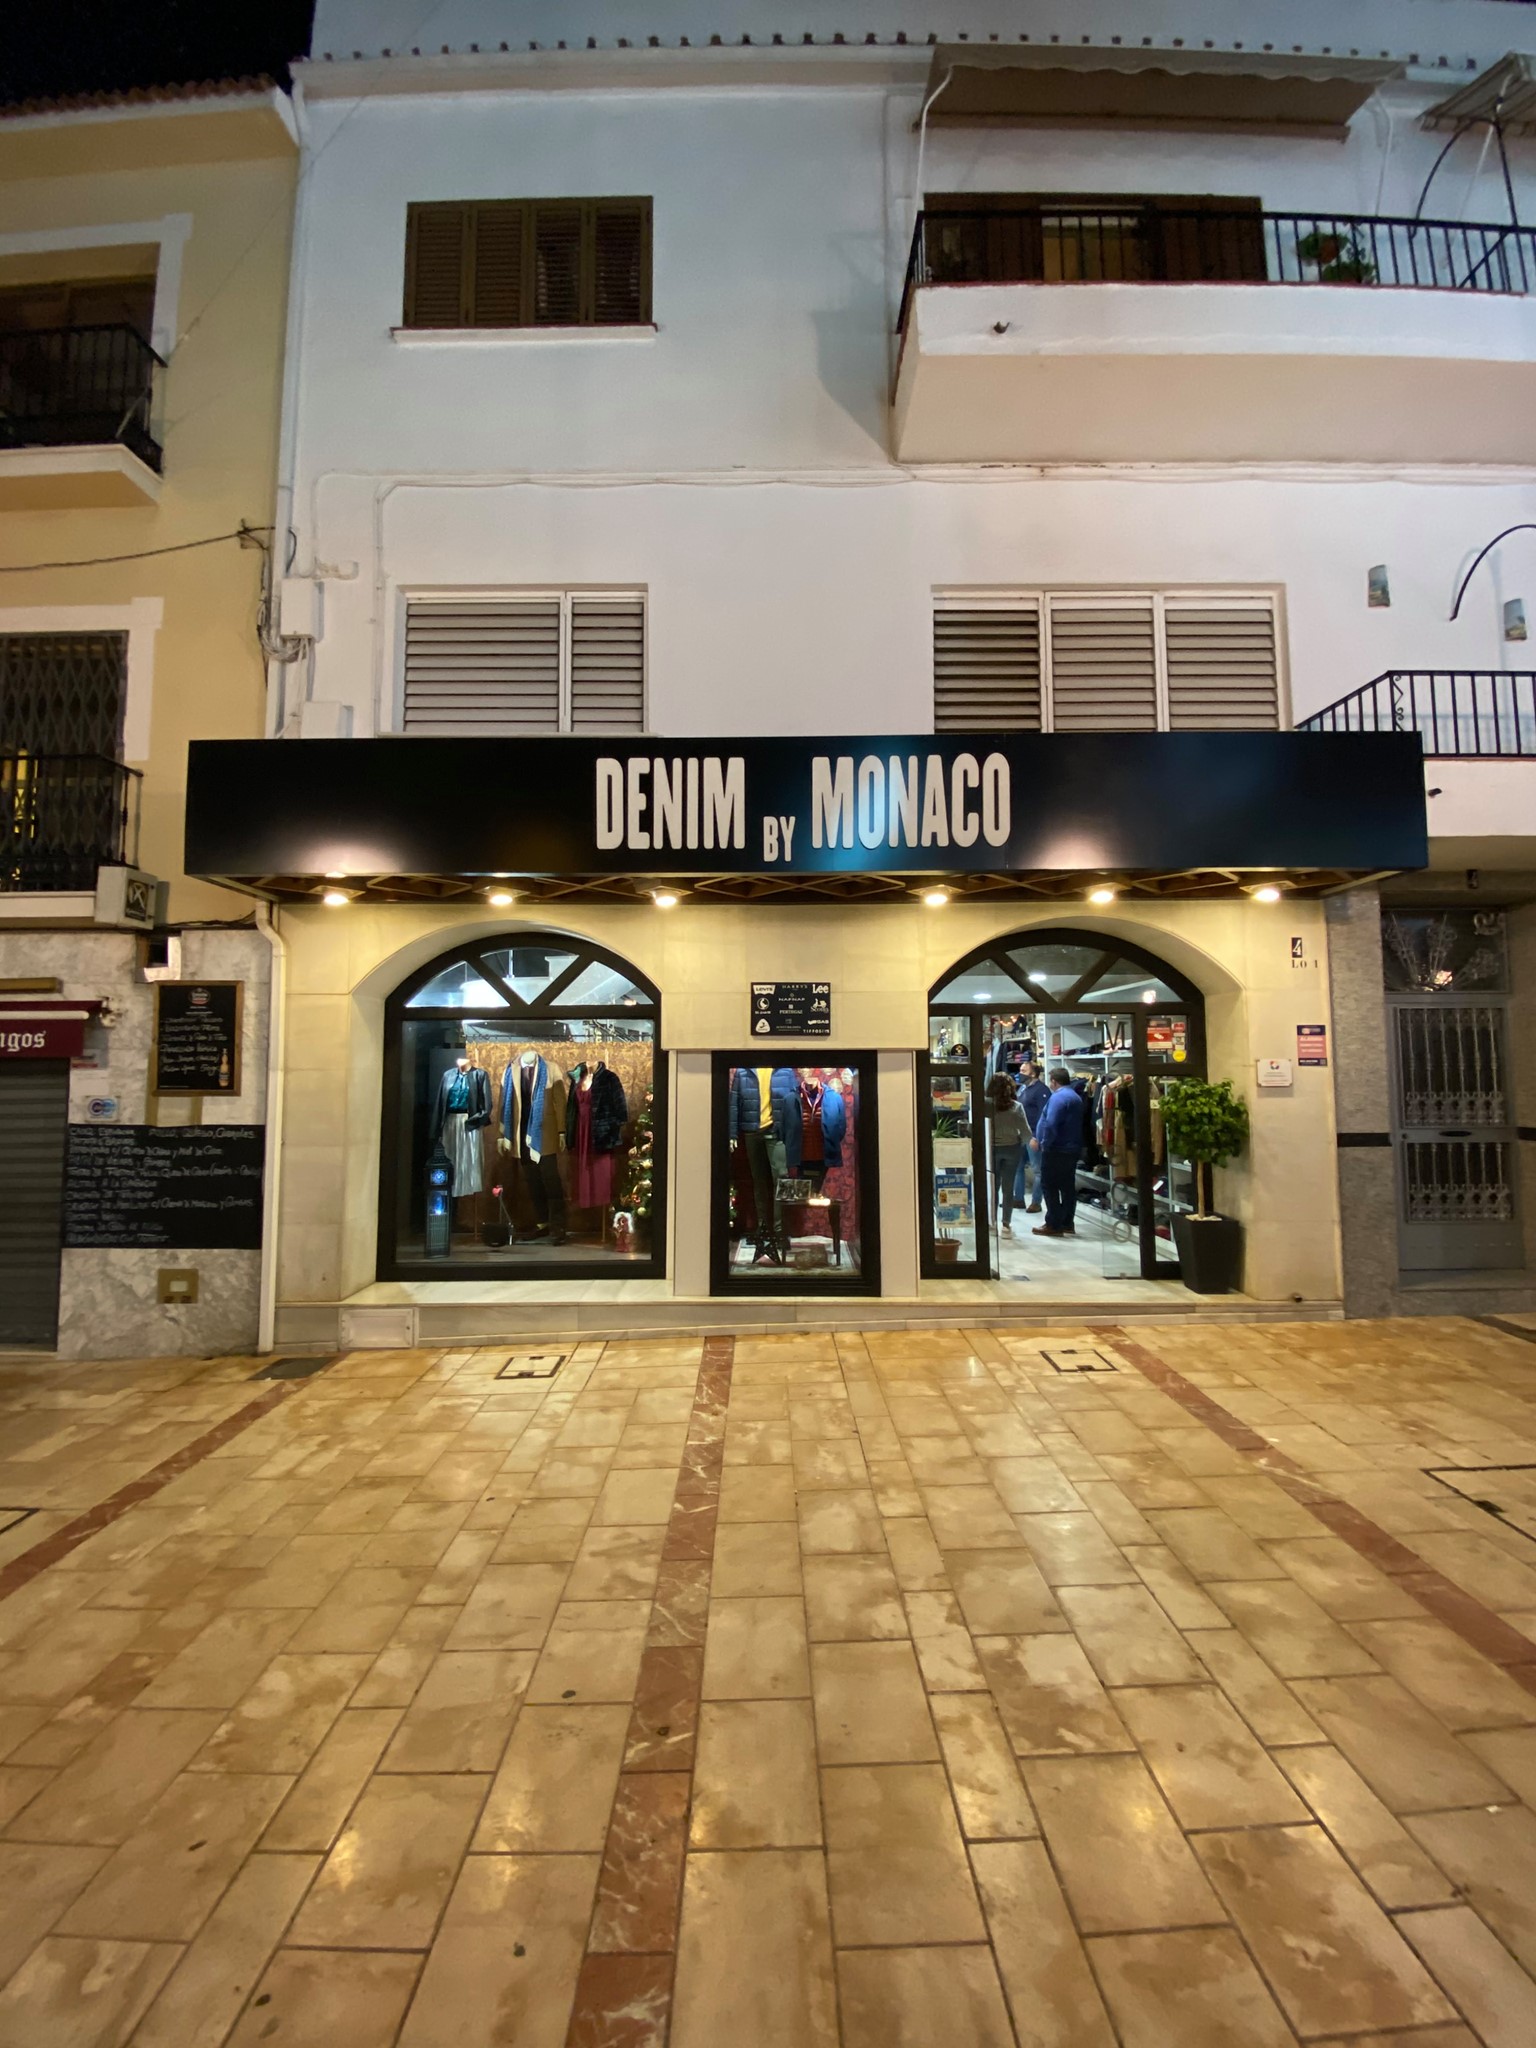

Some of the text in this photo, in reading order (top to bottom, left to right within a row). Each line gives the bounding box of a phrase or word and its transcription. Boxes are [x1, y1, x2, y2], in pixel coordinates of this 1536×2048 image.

[596, 752, 1011, 862] DENIM BY MONACO
[1292, 938, 1302, 956] 4
[812, 984, 829, 993] Lee
